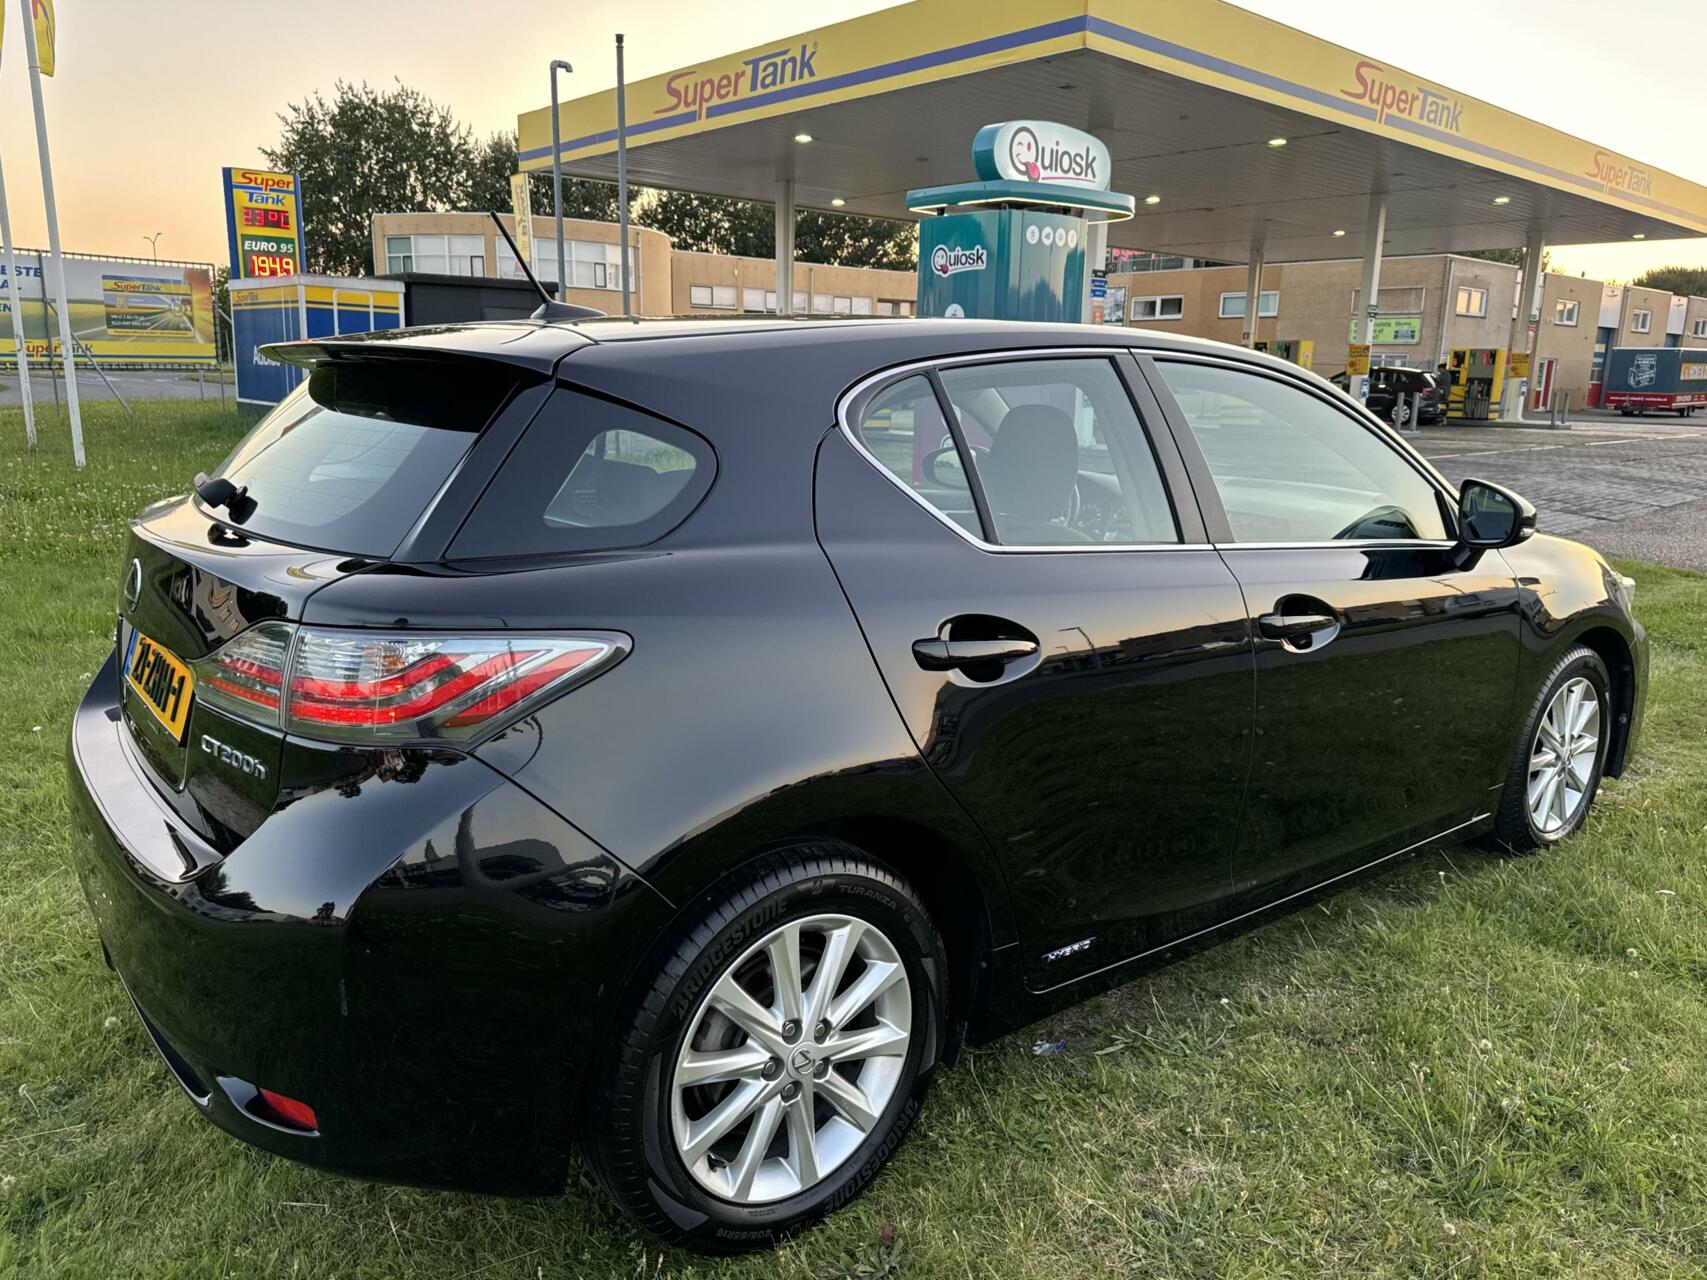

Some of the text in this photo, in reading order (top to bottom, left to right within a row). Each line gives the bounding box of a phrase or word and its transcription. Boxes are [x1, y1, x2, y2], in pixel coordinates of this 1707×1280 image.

[654, 44, 818, 121] SuperTank
[1340, 61, 1463, 132] SuperTank
[1009, 126, 1097, 182] Quiosk
[1585, 150, 1654, 196] SuperTank
[233, 171, 294, 192] Super
[244, 191, 286, 206] Tank
[244, 240, 294, 254] EURO 95
[933, 247, 985, 276] Quiosk
[839, 884, 898, 911] TURANZA
[671, 899, 789, 1018] BRIDGESTONE
[823, 1096, 919, 1214] BRIDGESTONE
